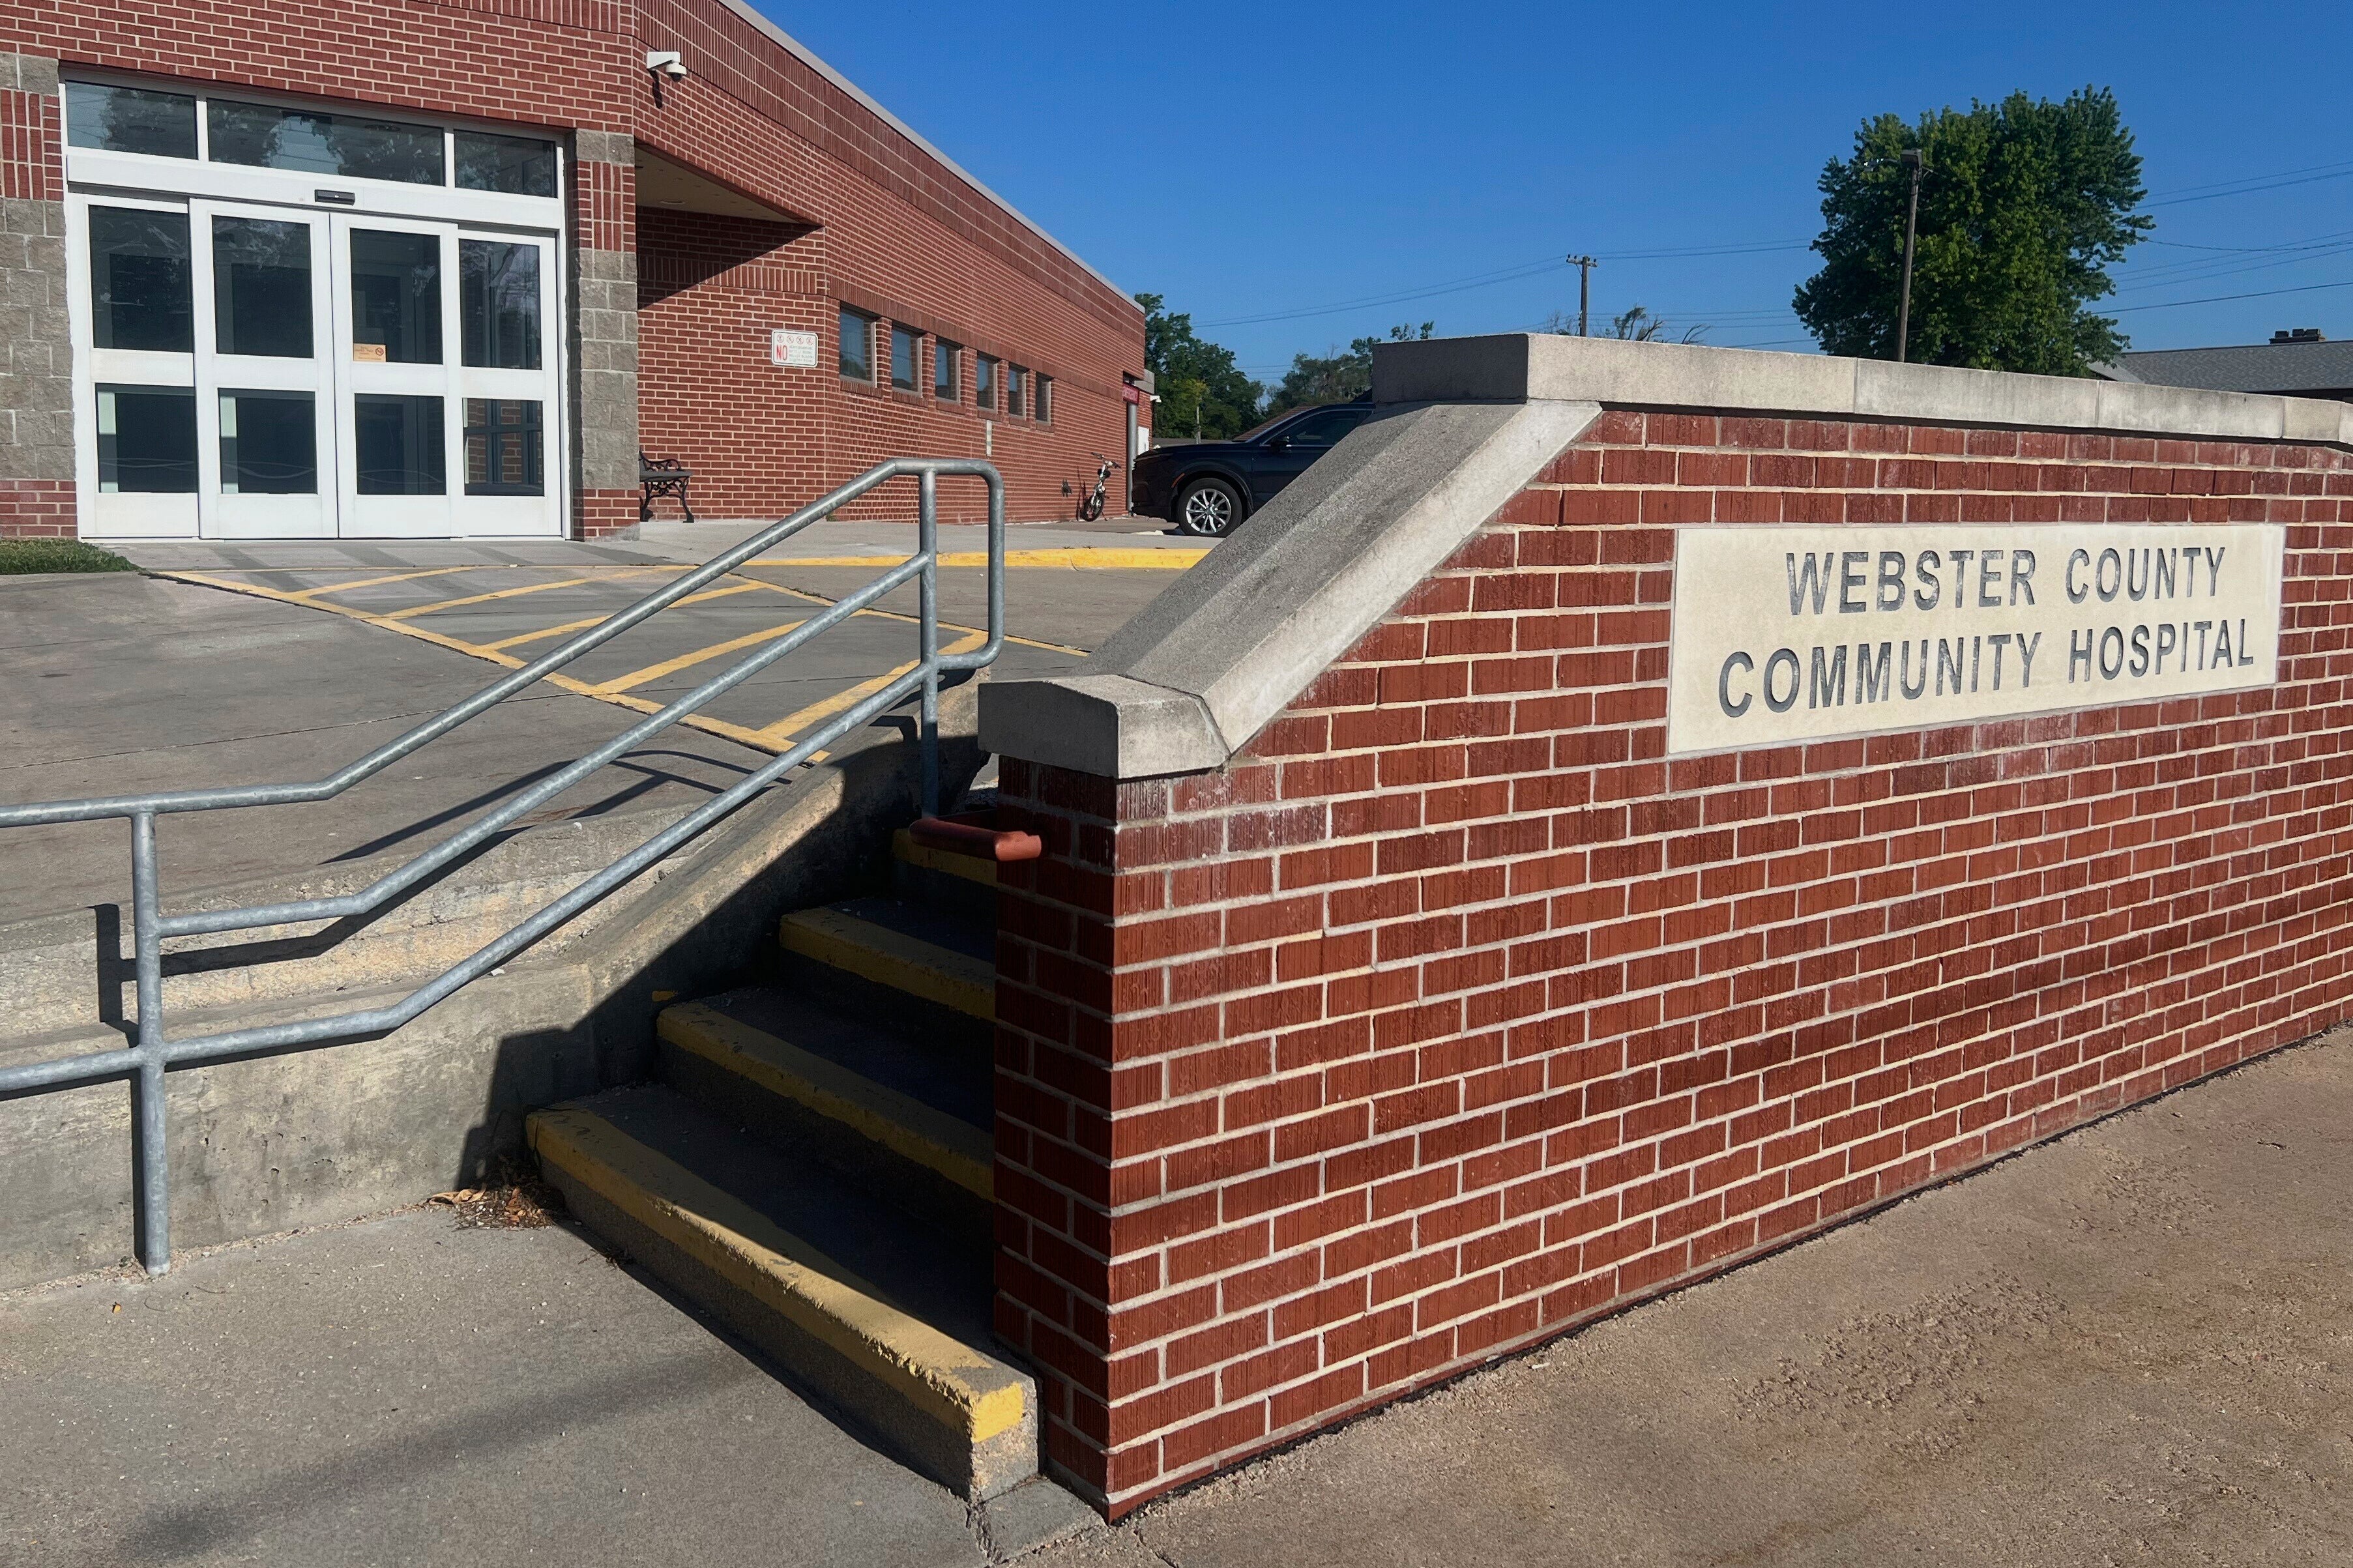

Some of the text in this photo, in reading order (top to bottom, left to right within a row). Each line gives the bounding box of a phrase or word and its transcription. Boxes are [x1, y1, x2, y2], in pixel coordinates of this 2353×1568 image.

[776, 344, 787, 360] NO
[1785, 546, 2227, 617] WEBSTER COUNTY
[1717, 618, 2255, 719] COMMUNITY HOSPITAL
